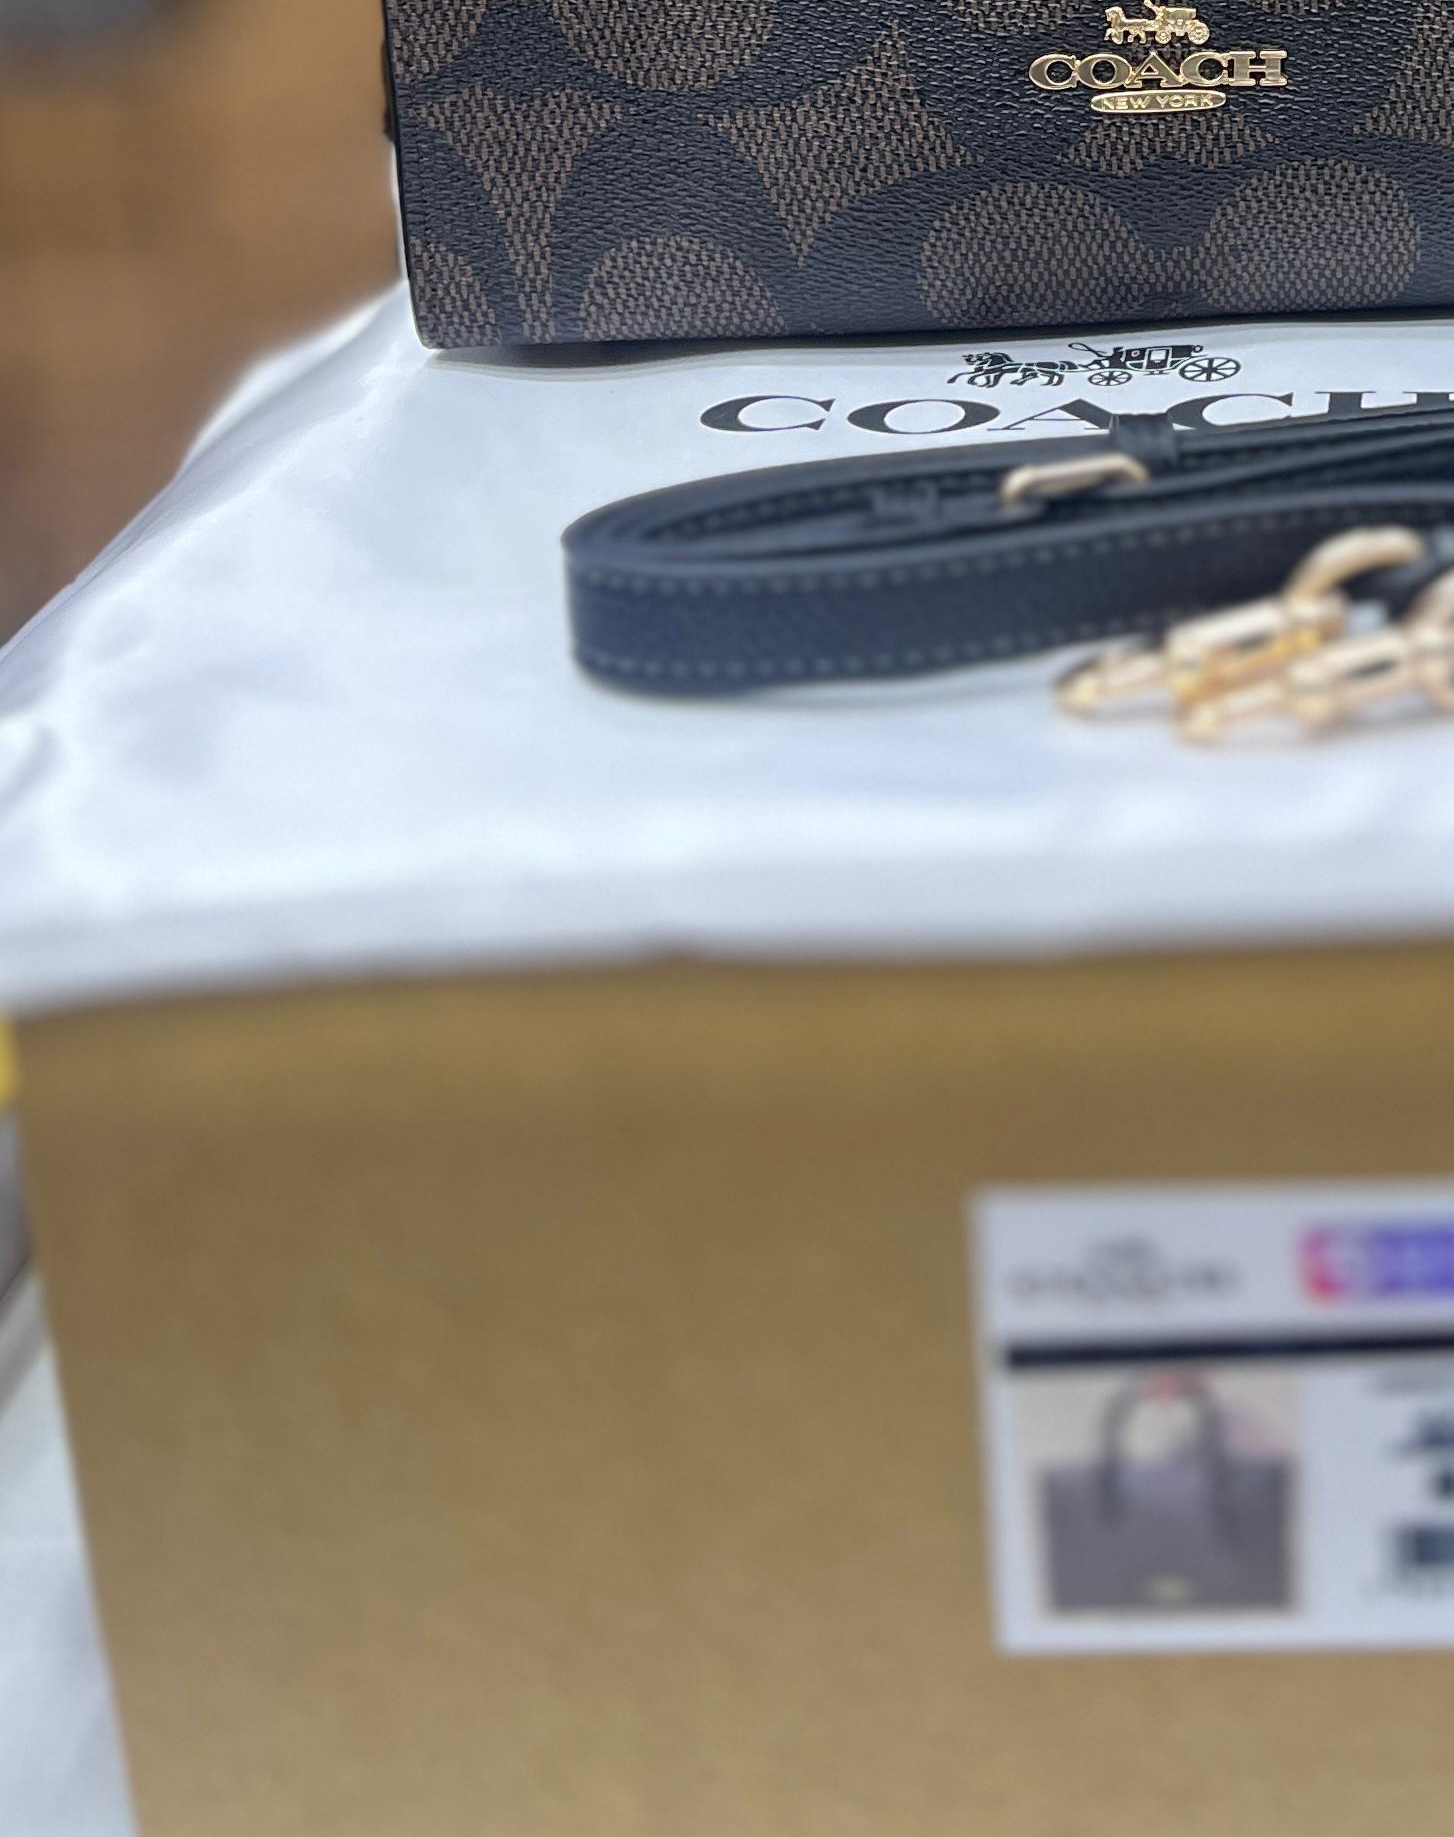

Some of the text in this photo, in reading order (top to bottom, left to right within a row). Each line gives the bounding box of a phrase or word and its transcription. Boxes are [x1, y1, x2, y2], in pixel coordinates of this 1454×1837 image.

[1028, 50, 1289, 90] COACH
[1101, 94, 1214, 110] NEW YORK
